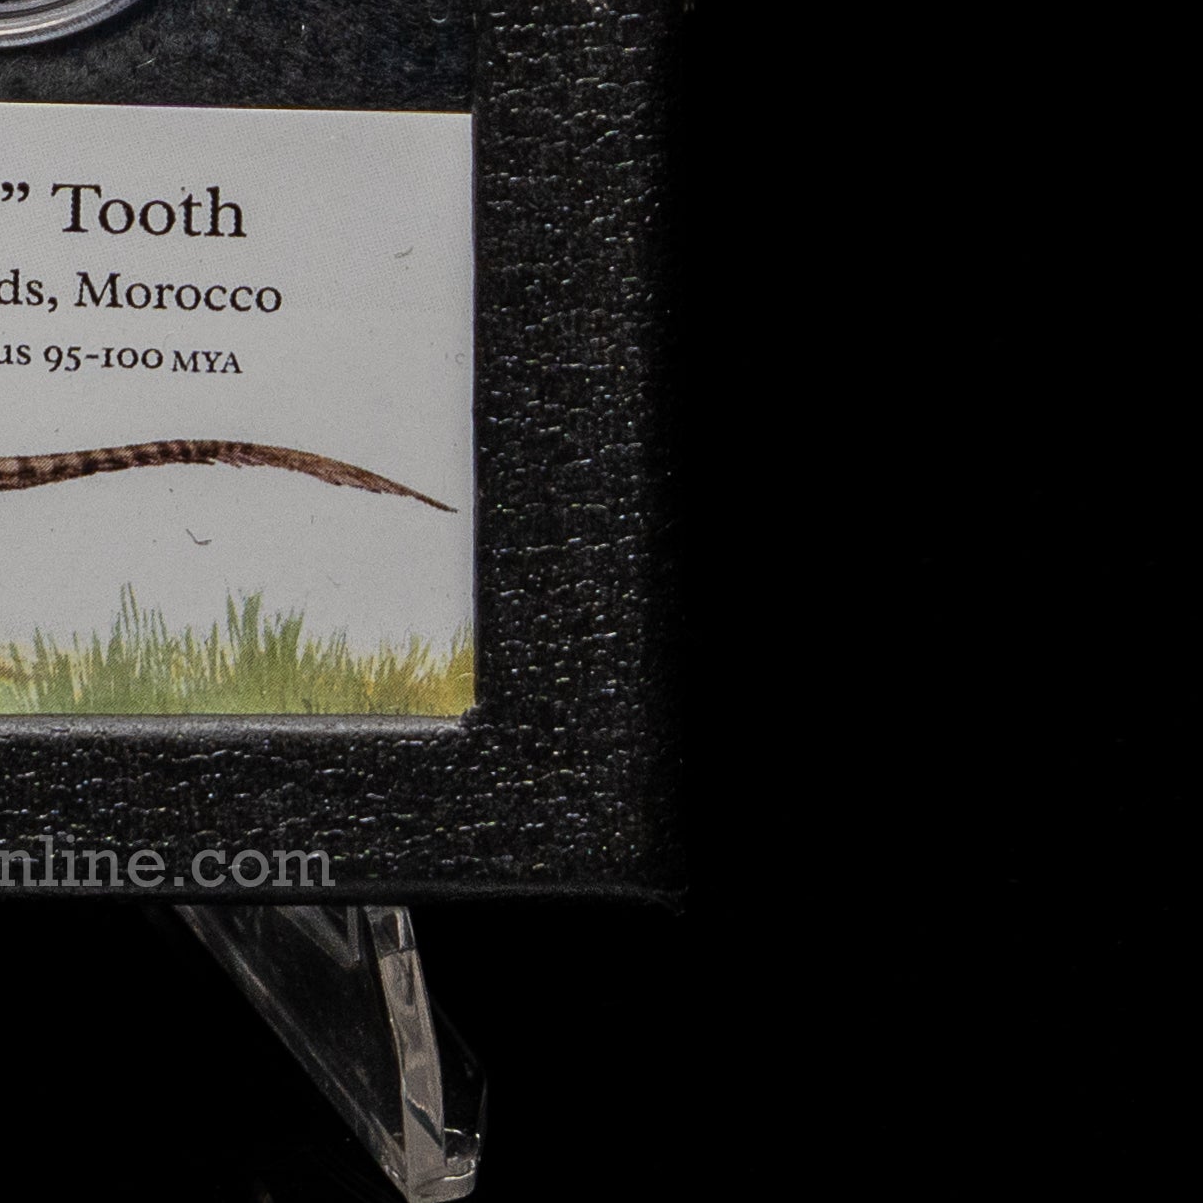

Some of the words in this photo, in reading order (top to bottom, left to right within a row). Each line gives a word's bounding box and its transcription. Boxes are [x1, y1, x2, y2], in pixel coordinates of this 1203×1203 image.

[50, 182, 248, 239] Tooth
[73, 271, 283, 314] Morocco
[42, 345, 164, 374] 95-100
[171, 349, 244, 375] MYA
